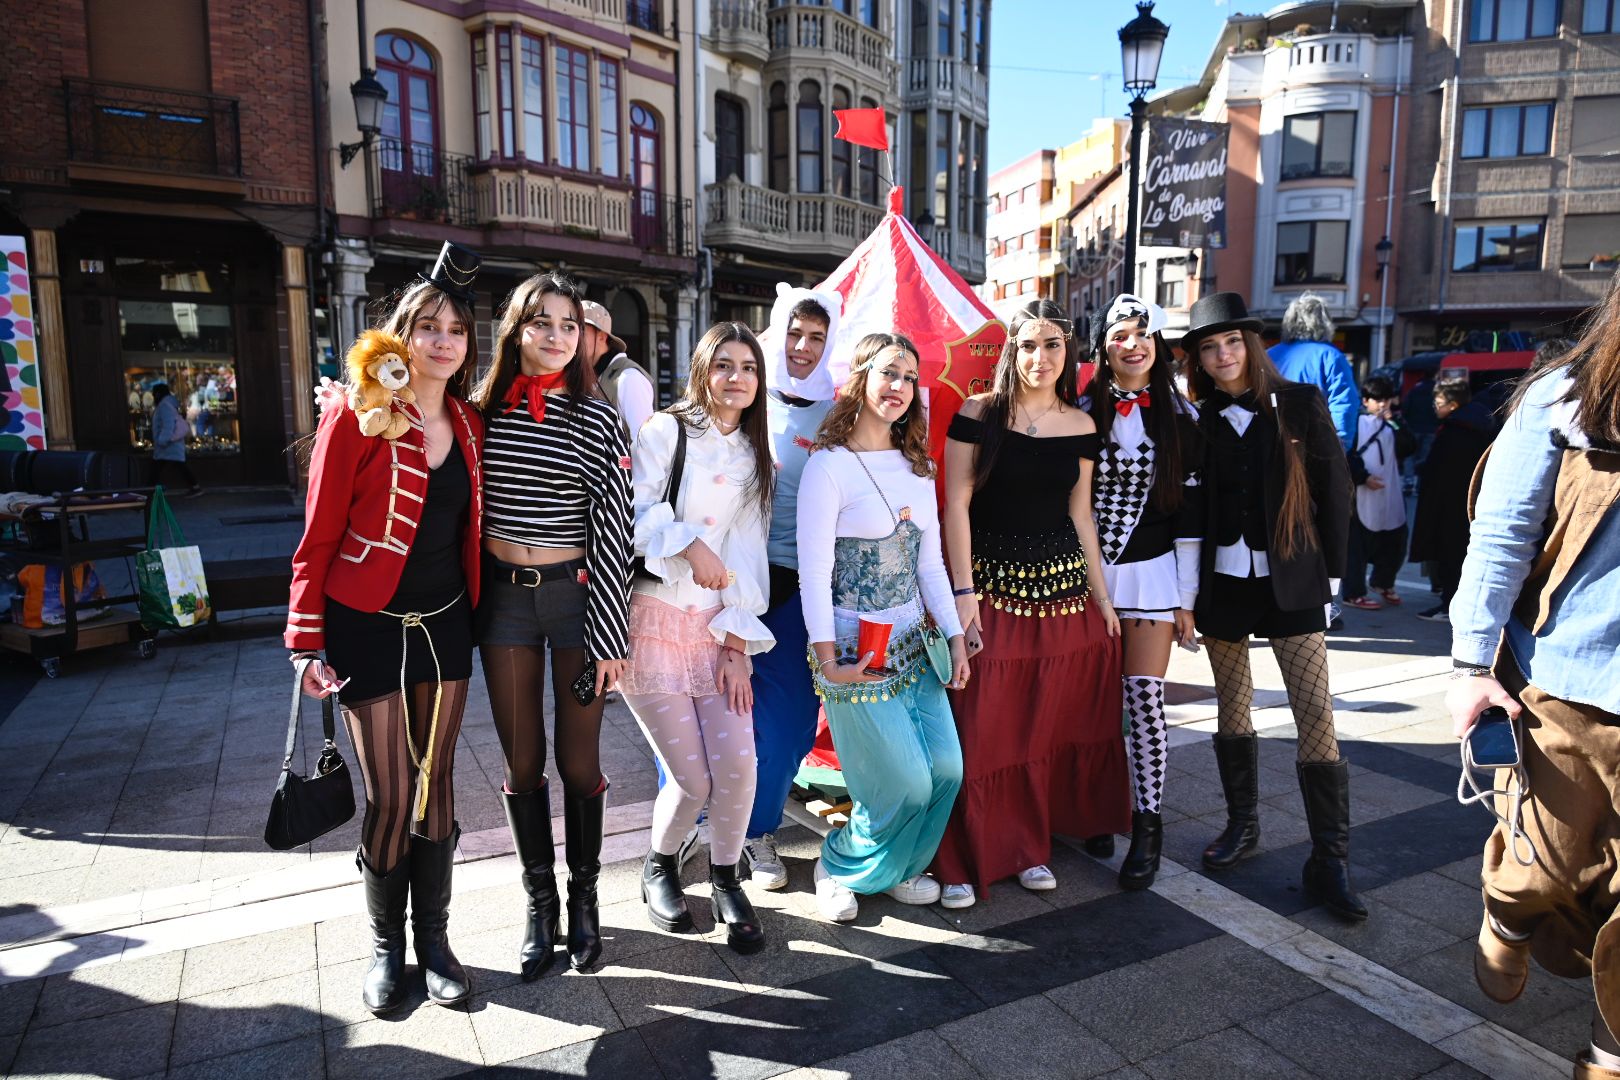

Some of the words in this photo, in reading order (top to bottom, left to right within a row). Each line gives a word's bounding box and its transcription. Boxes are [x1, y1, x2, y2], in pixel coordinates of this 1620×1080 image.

[1168, 129, 1208, 151] Vive
[1164, 150, 1174, 163] el
[1145, 148, 1227, 193] Carnaval
[1158, 188, 1172, 203] de
[1142, 200, 1165, 228] La
[1168, 193, 1224, 223] Bañeza
